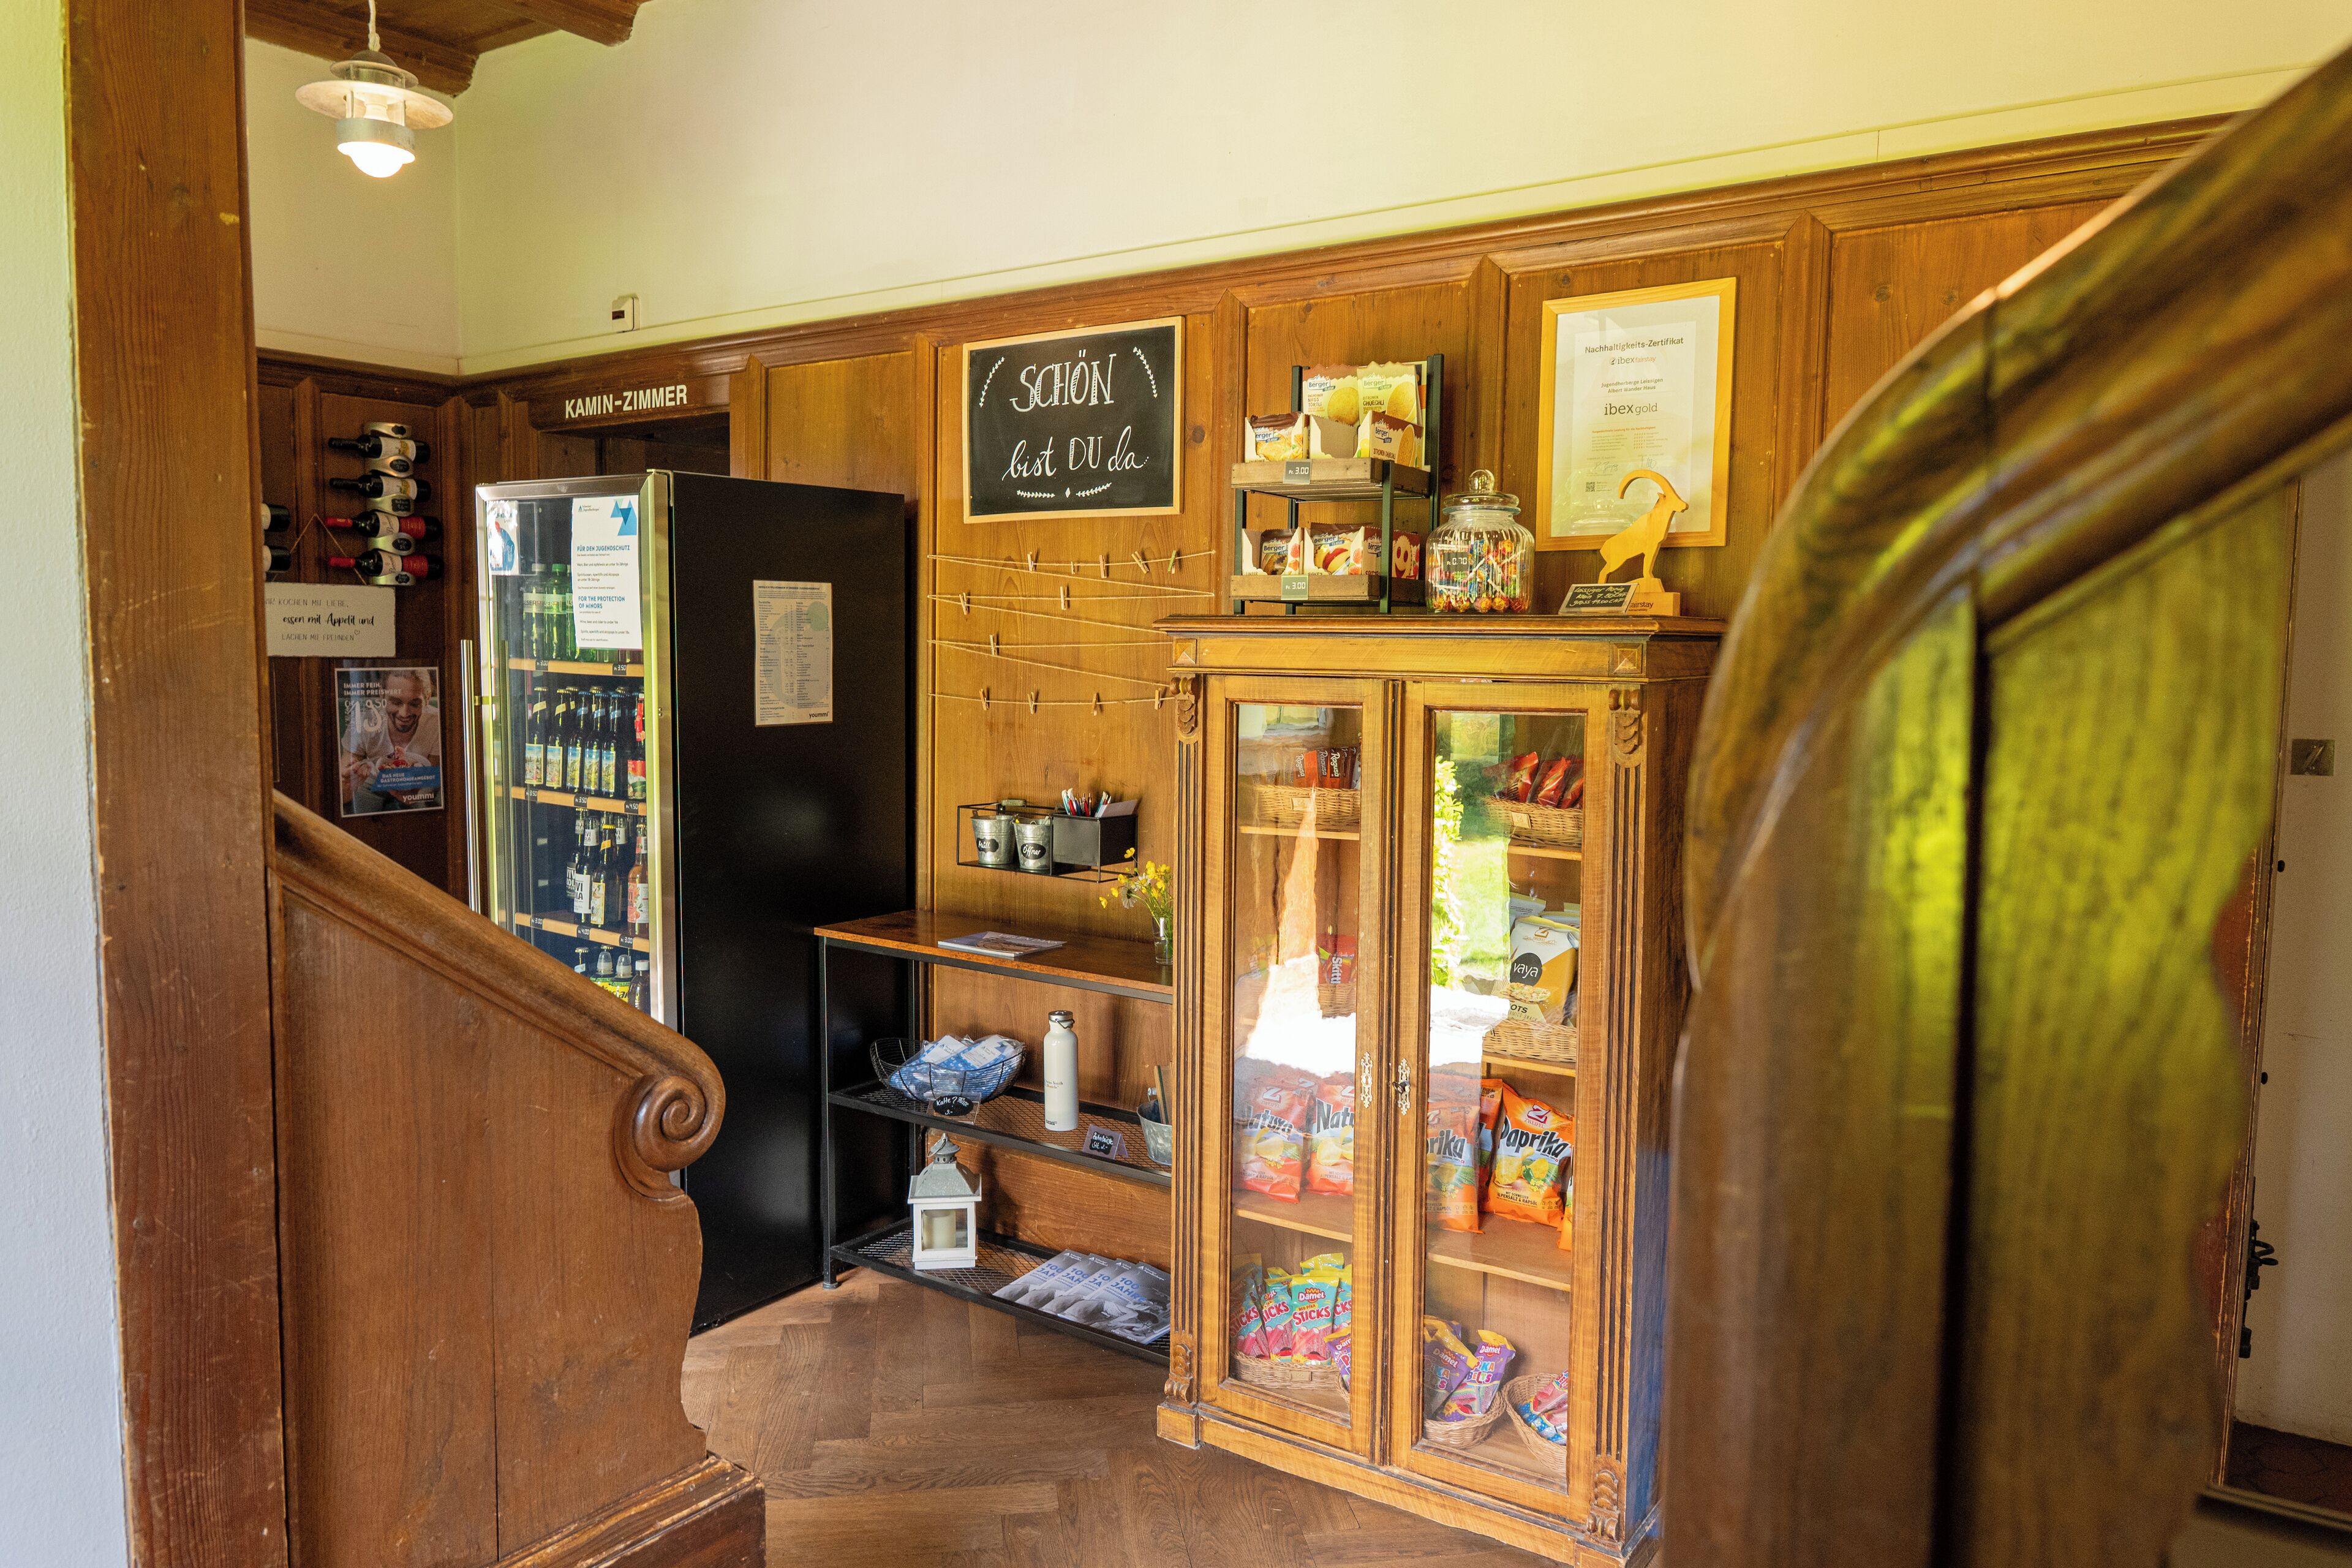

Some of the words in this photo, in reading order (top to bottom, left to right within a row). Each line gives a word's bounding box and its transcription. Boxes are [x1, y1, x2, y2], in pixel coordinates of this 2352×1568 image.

[1585, 337, 1684, 353] Nachhaltigkeits-Zertifikat
[1009, 350, 1116, 412] SCHÖN
[565, 385, 687, 418] KAMIN-ZIMMER
[1375, 427, 1388, 437] Berger
[1002, 437, 1057, 481] bist
[1069, 436, 1102, 470] DU
[1452, 557, 1468, 565] 0.70
[283, 616, 304, 625] essen
[307, 614, 321, 625] mit
[326, 612, 355, 627] Appetit
[358, 616, 374, 625] und
[1295, 753, 1305, 777] Ragusa
[1330, 752, 1340, 777] Ragusa
[1023, 844, 1041, 857] Öffner
[1513, 962, 1539, 979] vaya
[1524, 1118, 1544, 1129] ZWEIFEL
[1120, 1276, 1140, 1289] 100
[1110, 1281, 1147, 1303] JAHRE
[1298, 1291, 1325, 1302] Damel
[1292, 1305, 1331, 1326] STICKS
[1479, 1345, 1501, 1354] Damel
[1433, 1348, 1458, 1368] Damel
[1466, 1371, 1493, 1384] BELTS
